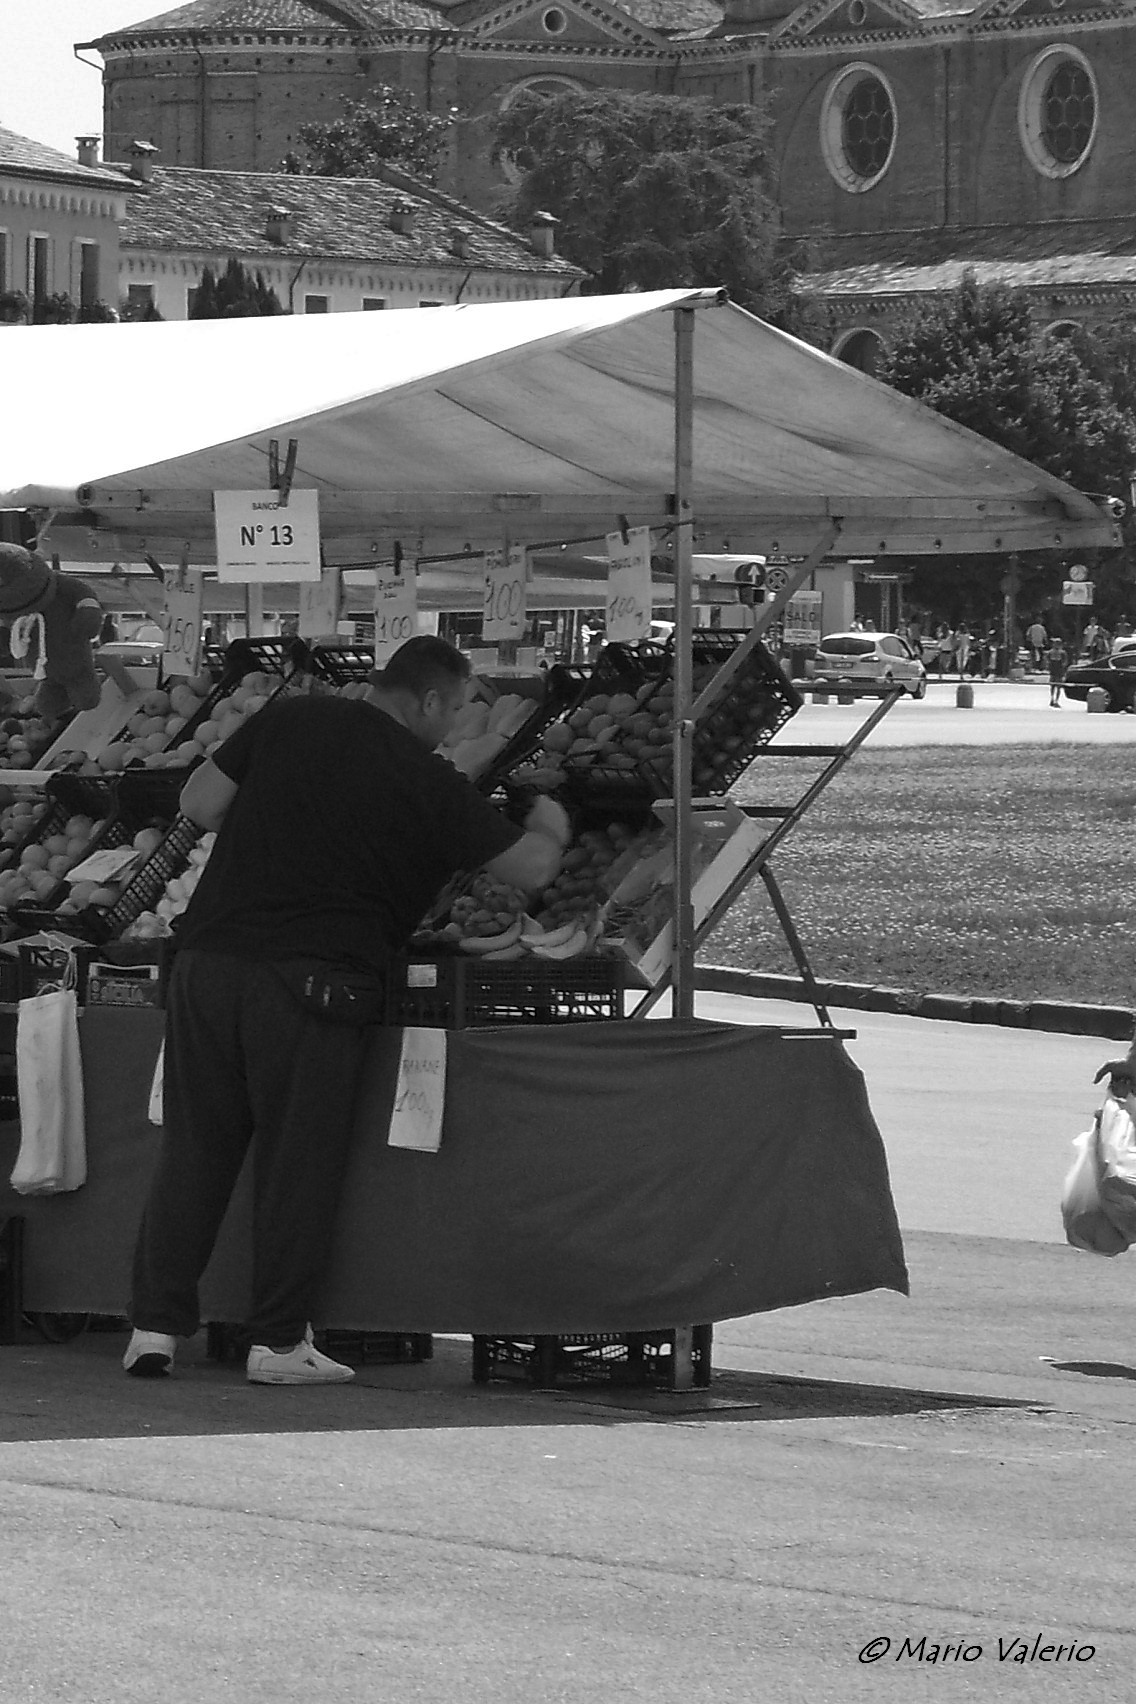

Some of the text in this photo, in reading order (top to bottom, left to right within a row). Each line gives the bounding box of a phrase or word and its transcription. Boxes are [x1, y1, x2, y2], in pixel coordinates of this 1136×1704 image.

[251, 502, 279, 511] BANCO
[240, 524, 294, 546] N° 13
